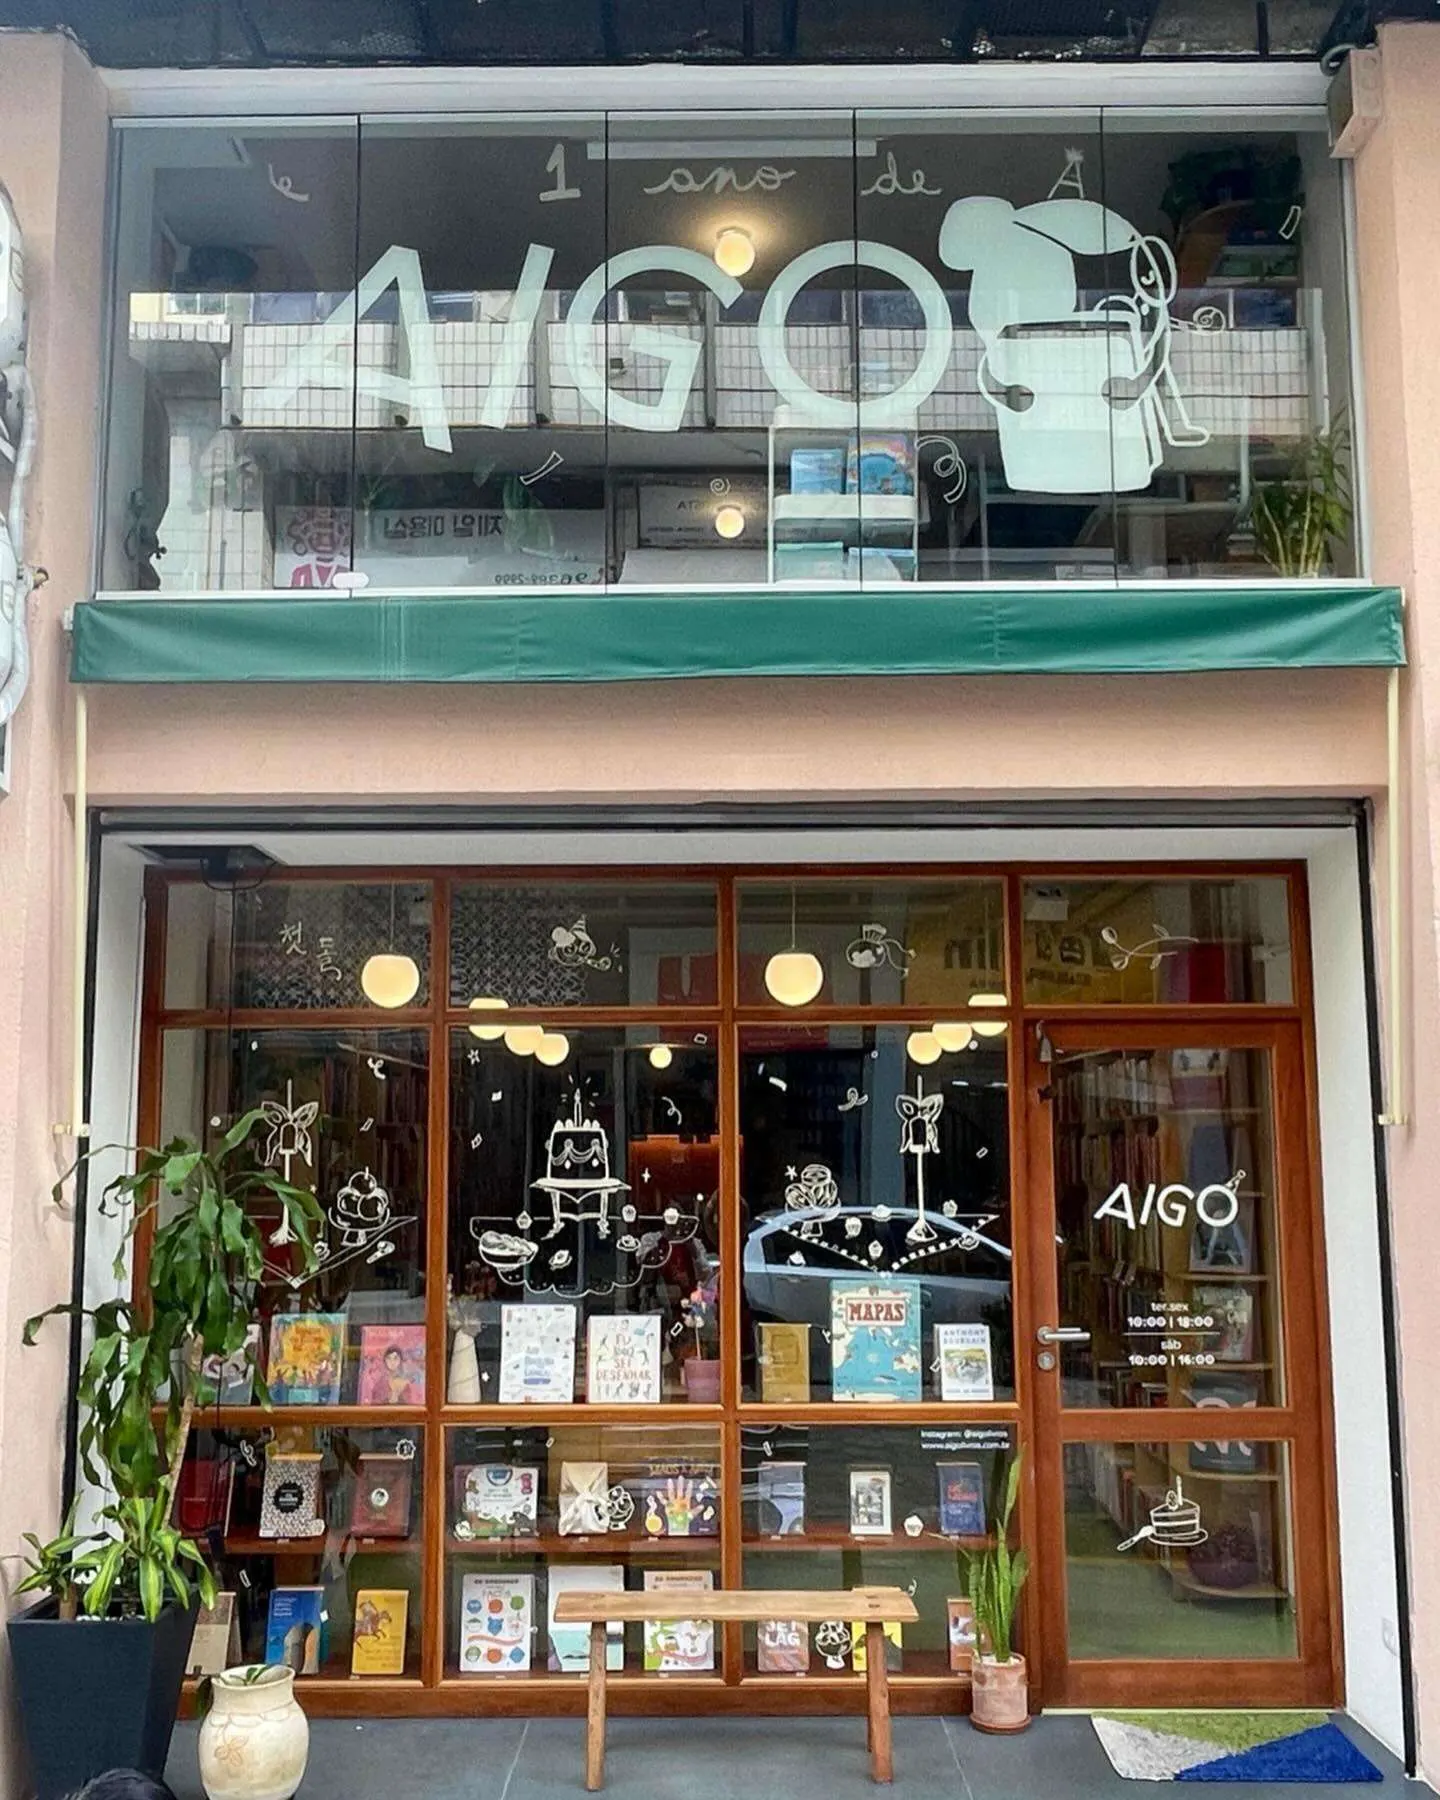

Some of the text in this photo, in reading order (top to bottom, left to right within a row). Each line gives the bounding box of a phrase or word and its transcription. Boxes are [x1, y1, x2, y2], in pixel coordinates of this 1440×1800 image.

[539, 142, 942, 201] 1 ano de
[262, 240, 953, 453] AIGO
[1093, 1181, 1239, 1230] AIGO
[849, 1303, 905, 1321] MAPAS
[1127, 1316, 1166, 1328] 10:00
[1128, 1354, 1168, 1366] 10:00
[1178, 1354, 1215, 1366] 16:00
[764, 1631, 801, 1647] LAG
